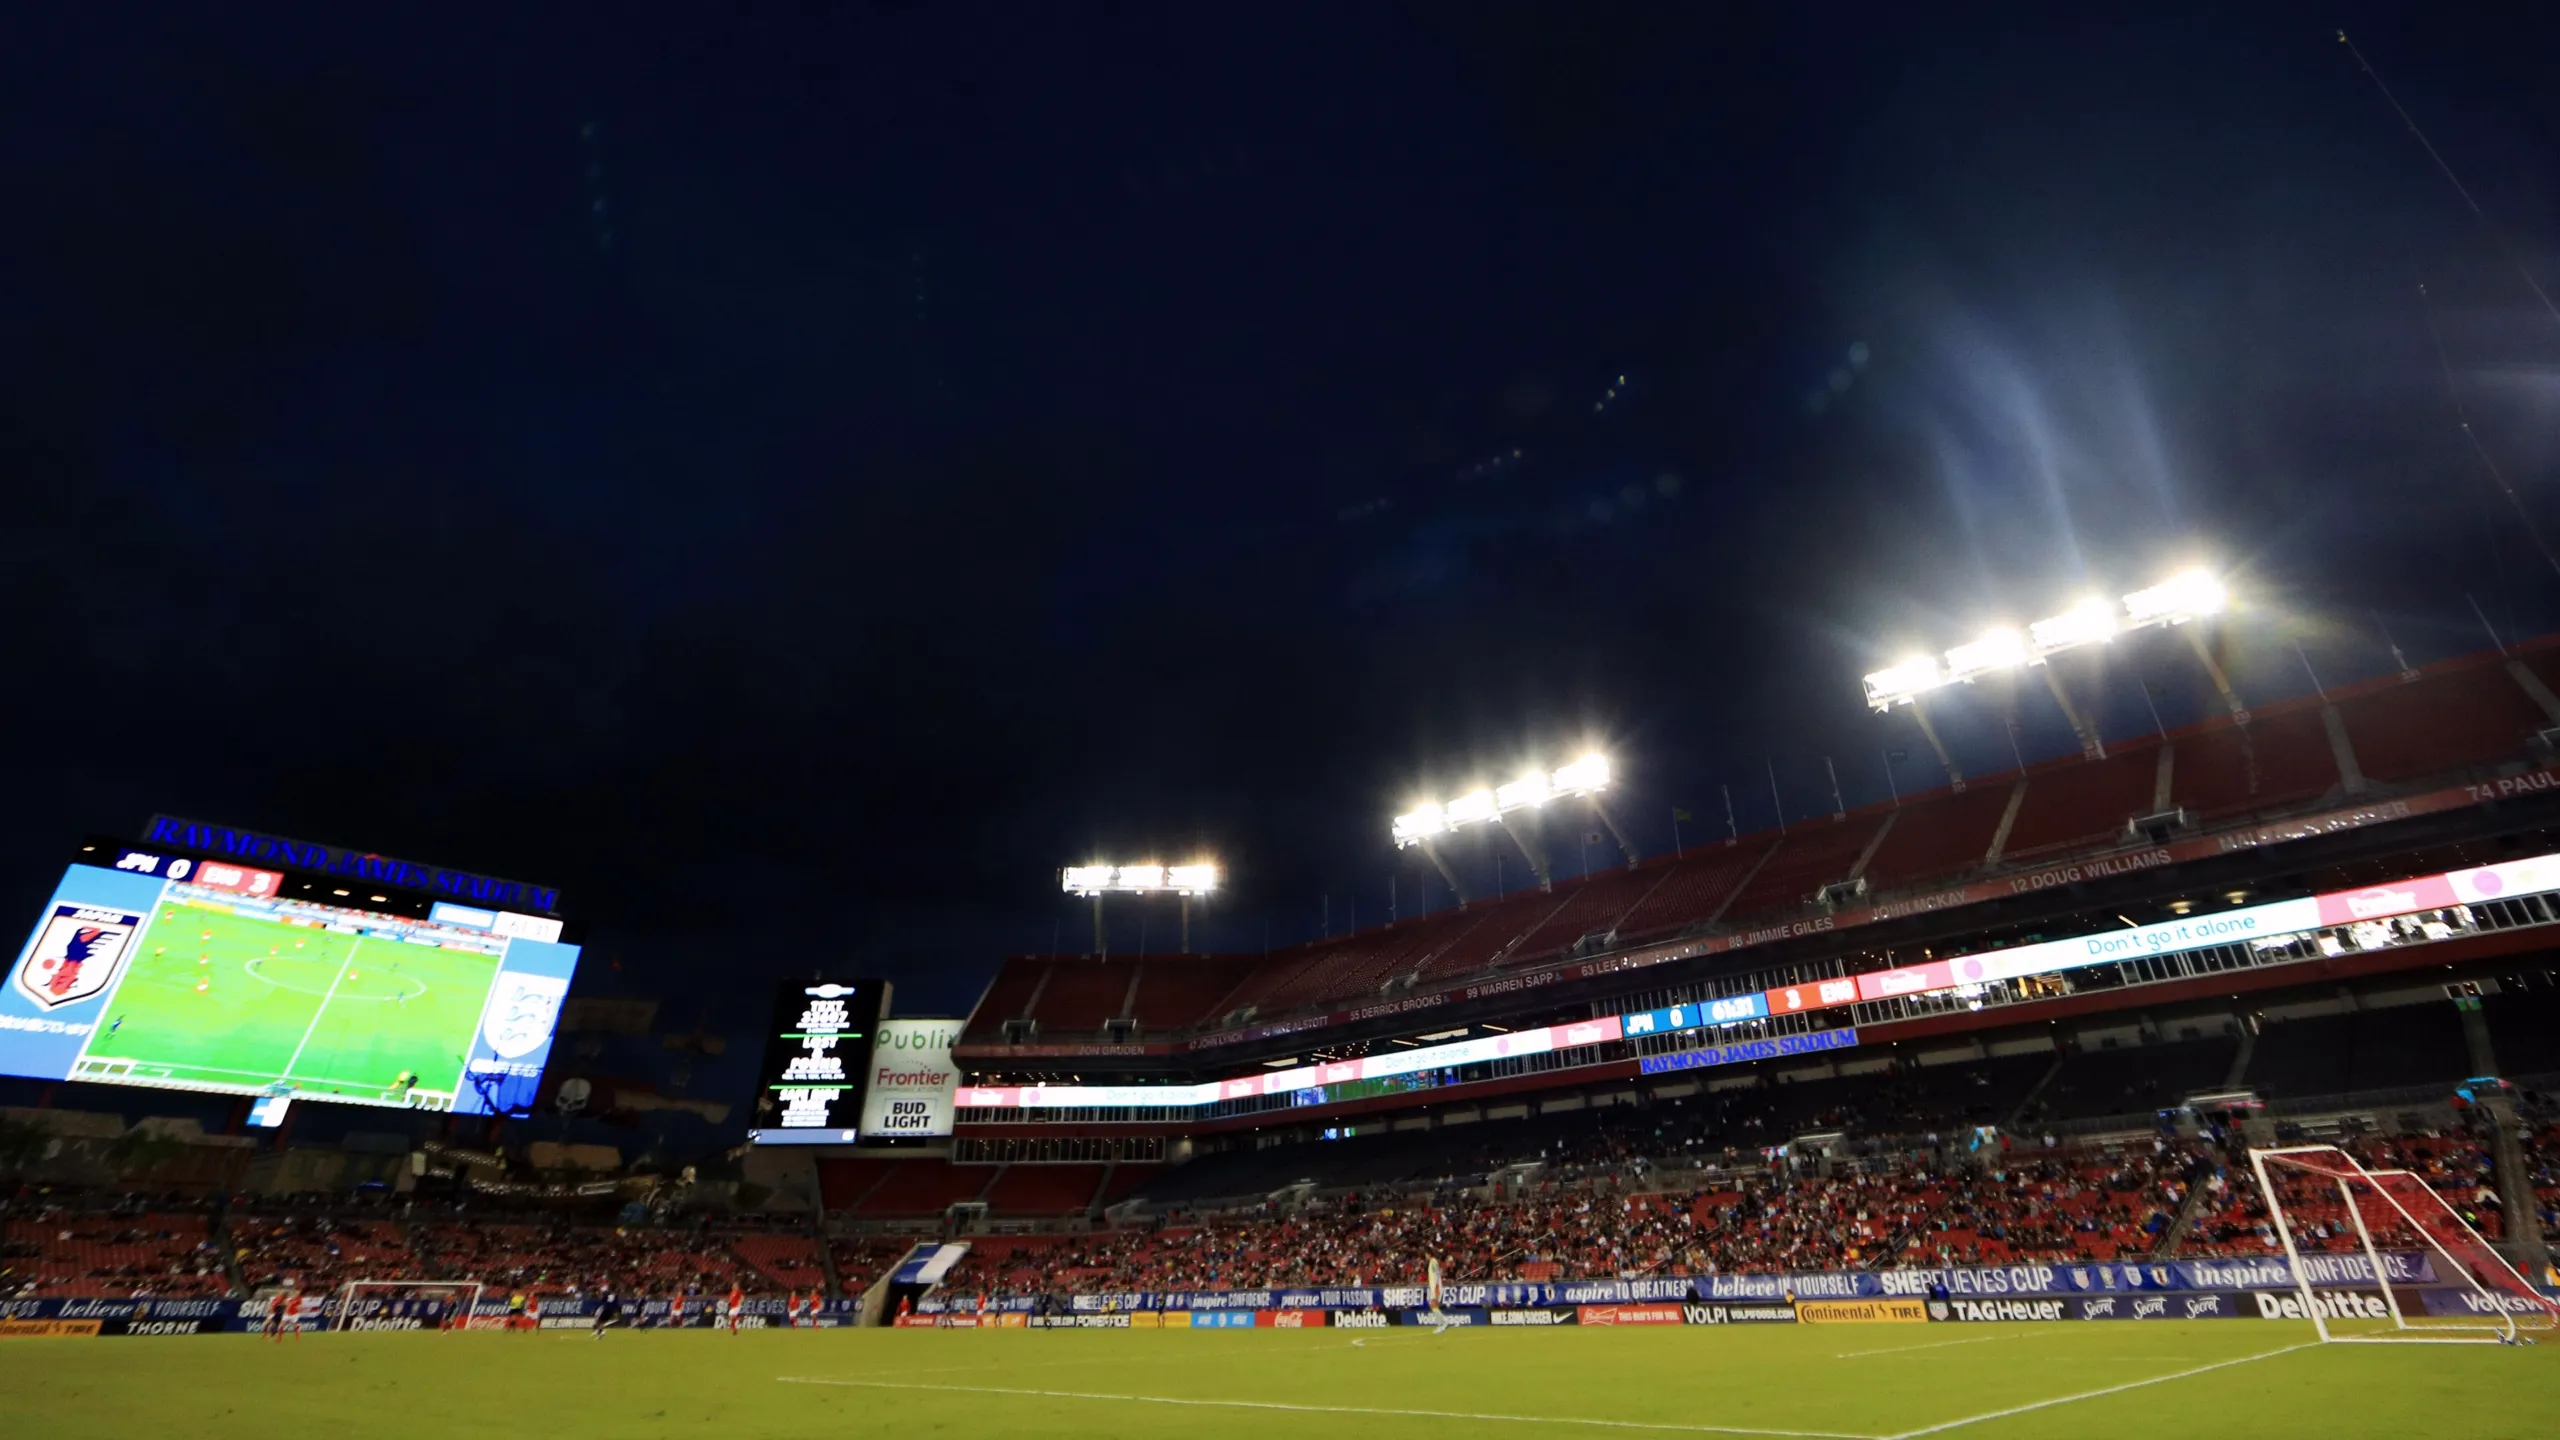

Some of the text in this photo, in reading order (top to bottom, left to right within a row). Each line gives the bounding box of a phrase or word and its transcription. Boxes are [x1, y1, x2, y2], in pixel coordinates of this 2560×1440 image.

[2465, 770, 2560, 802] 74 PAUL
[151, 816, 557, 912] RAYMOND JAMES STADIUM
[166, 858, 192, 880] 0
[2010, 848, 2173, 894] 12 DOUG WILLIAMS
[248, 873, 273, 893] 3
[1913, 889, 1967, 911] MCKAY
[1728, 916, 1835, 947] 88 JIMMIE GILES
[2086, 916, 2257, 956] Don't go it alone
[1581, 965, 1595, 976] 63
[1466, 972, 1554, 999] 99 WARREN SAPP
[1350, 994, 1442, 1021] 55 DERRICK BROOKS
[1784, 989, 1801, 1010] 3
[1291, 1015, 1329, 1032] ALSTOTT
[1626, 1012, 1654, 1035] JPN
[1669, 1008, 1684, 1028] 0
[1078, 1046, 1145, 1056] JON GRUDEN
[1640, 1027, 1857, 1075] RAYMOND JAMES STADIUM
[876, 1068, 951, 1086] Frontier
[892, 1102, 926, 1114] BUD
[884, 1115, 931, 1128] LIGHT
[2010, 1267, 2053, 1292] CUP
[2193, 1256, 2413, 1289] inspire ONFIDECE
[1458, 1286, 1486, 1304] CUP
[1565, 1283, 1619, 1304] aspire
[1615, 1283, 1630, 1299] TO
[1712, 1276, 1775, 1297] believe
[1795, 1274, 1860, 1296] YOURSELF
[58, 1299, 136, 1318] believe
[153, 1300, 220, 1317] YOURSELF
[1125, 1294, 1142, 1310] CUP
[1192, 1292, 1270, 1310] inspire CONFIDENCE
[1281, 1290, 1374, 1308] pursue YOUR PASSION
[2083, 1297, 2117, 1321] Secret
[2133, 1297, 2168, 1321] Secret
[2185, 1294, 2221, 1320] Secret
[1334, 1310, 1387, 1328] Deloitte
[1683, 1305, 1729, 1324] VOLPI
[1800, 1304, 1876, 1322] Continental
[1890, 1306, 1923, 1319] TIRE
[127, 1320, 201, 1334] THORNE
[351, 1316, 423, 1332] Deloitte
